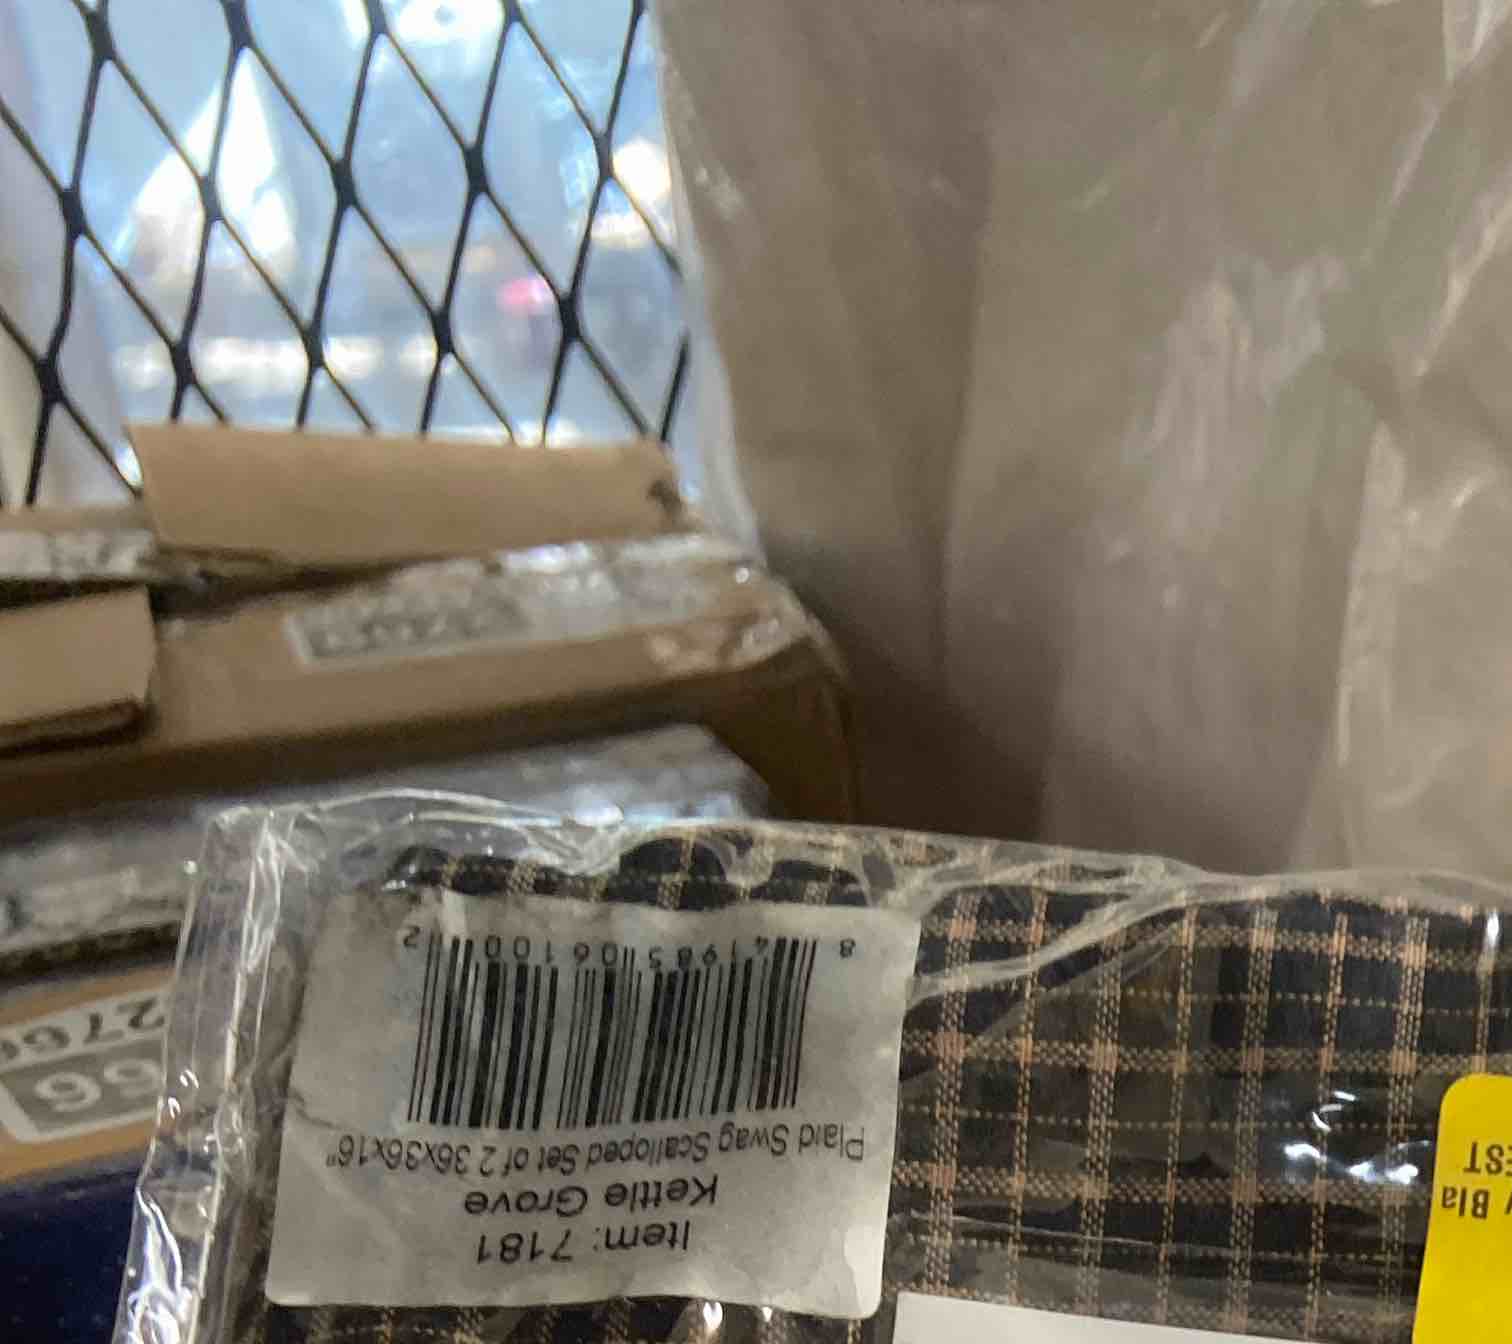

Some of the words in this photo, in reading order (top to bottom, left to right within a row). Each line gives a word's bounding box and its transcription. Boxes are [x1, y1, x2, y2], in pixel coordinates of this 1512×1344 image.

[325, 1134, 470, 1176] 36x36x16"
[584, 1130, 711, 1170] Scalloped
[716, 1119, 789, 1157] Swag
[797, 1122, 864, 1161] Plaid
[478, 1144, 496, 1177] 2
[500, 1146, 529, 1177] of
[536, 1143, 580, 1176] Set
[463, 1184, 588, 1218] Grove
[603, 1173, 718, 1213] Kettle
[1440, 1184, 1489, 1219] Bla
[475, 1228, 572, 1265] 7181
[592, 1219, 690, 1250] Item:
